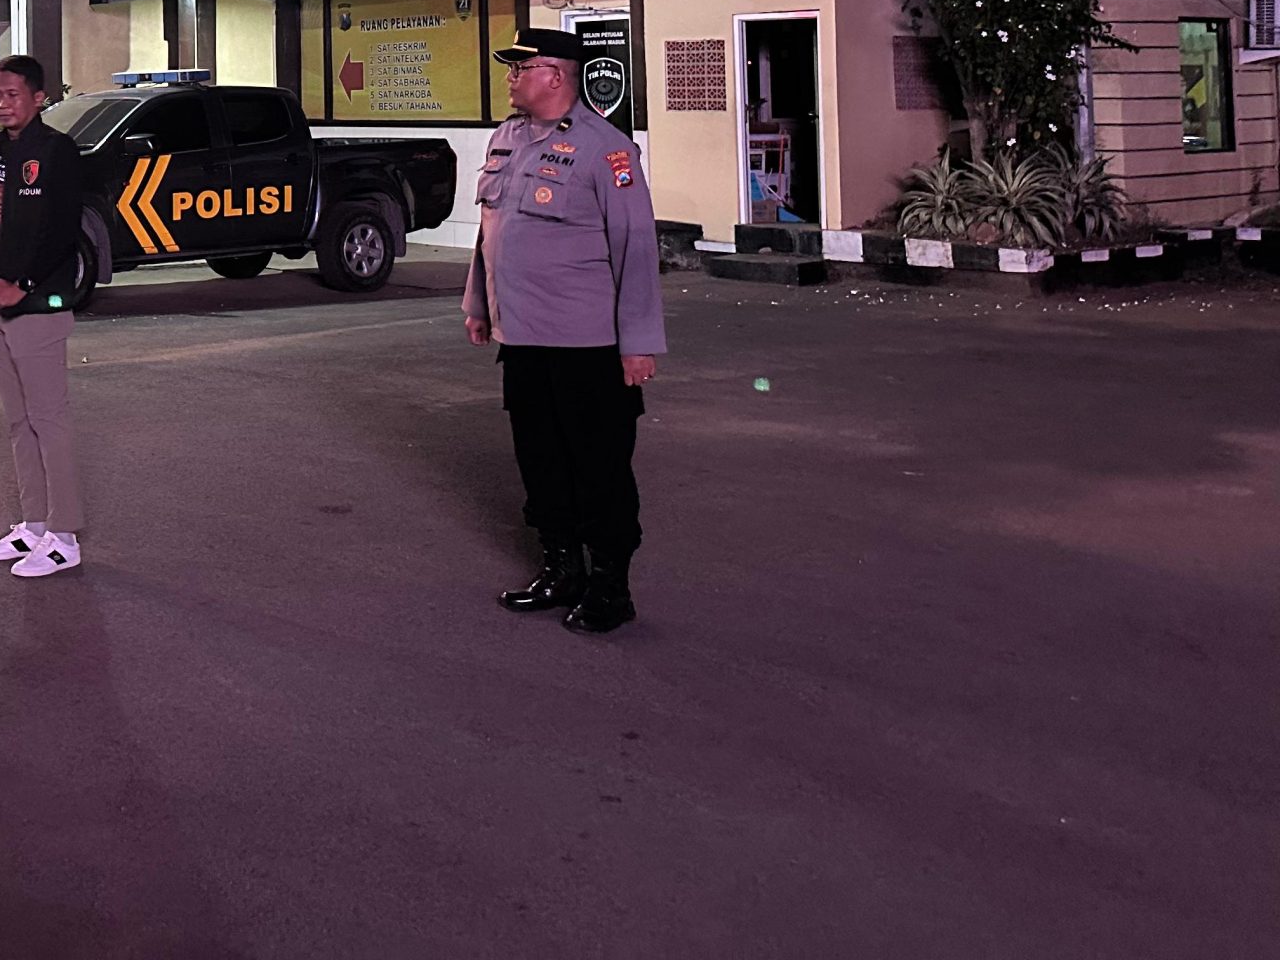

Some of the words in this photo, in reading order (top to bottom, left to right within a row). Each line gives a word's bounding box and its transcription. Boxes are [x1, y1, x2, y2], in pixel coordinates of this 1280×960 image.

[360, 19, 387, 31] RUANG
[390, 15, 441, 30] PELAYANAN
[377, 44, 392, 52] SAT
[393, 42, 427, 51] RESKRIM
[377, 55, 392, 64] SAT
[393, 54, 431, 63] INTELKAM
[378, 67, 392, 76] SAT
[394, 66, 423, 75] BINMAS
[588, 71, 599, 80] TIK
[600, 70, 621, 80] POLRI
[378, 79, 392, 87] SAT
[394, 77, 431, 87] SABHARA
[378, 90, 392, 99] SAT
[394, 89, 432, 98] NARKOBA
[378, 102, 404, 111] BESUK
[406, 100, 442, 111] TAHANAN
[540, 153, 574, 167] POLRI
[172, 185, 292, 221] POLISI
